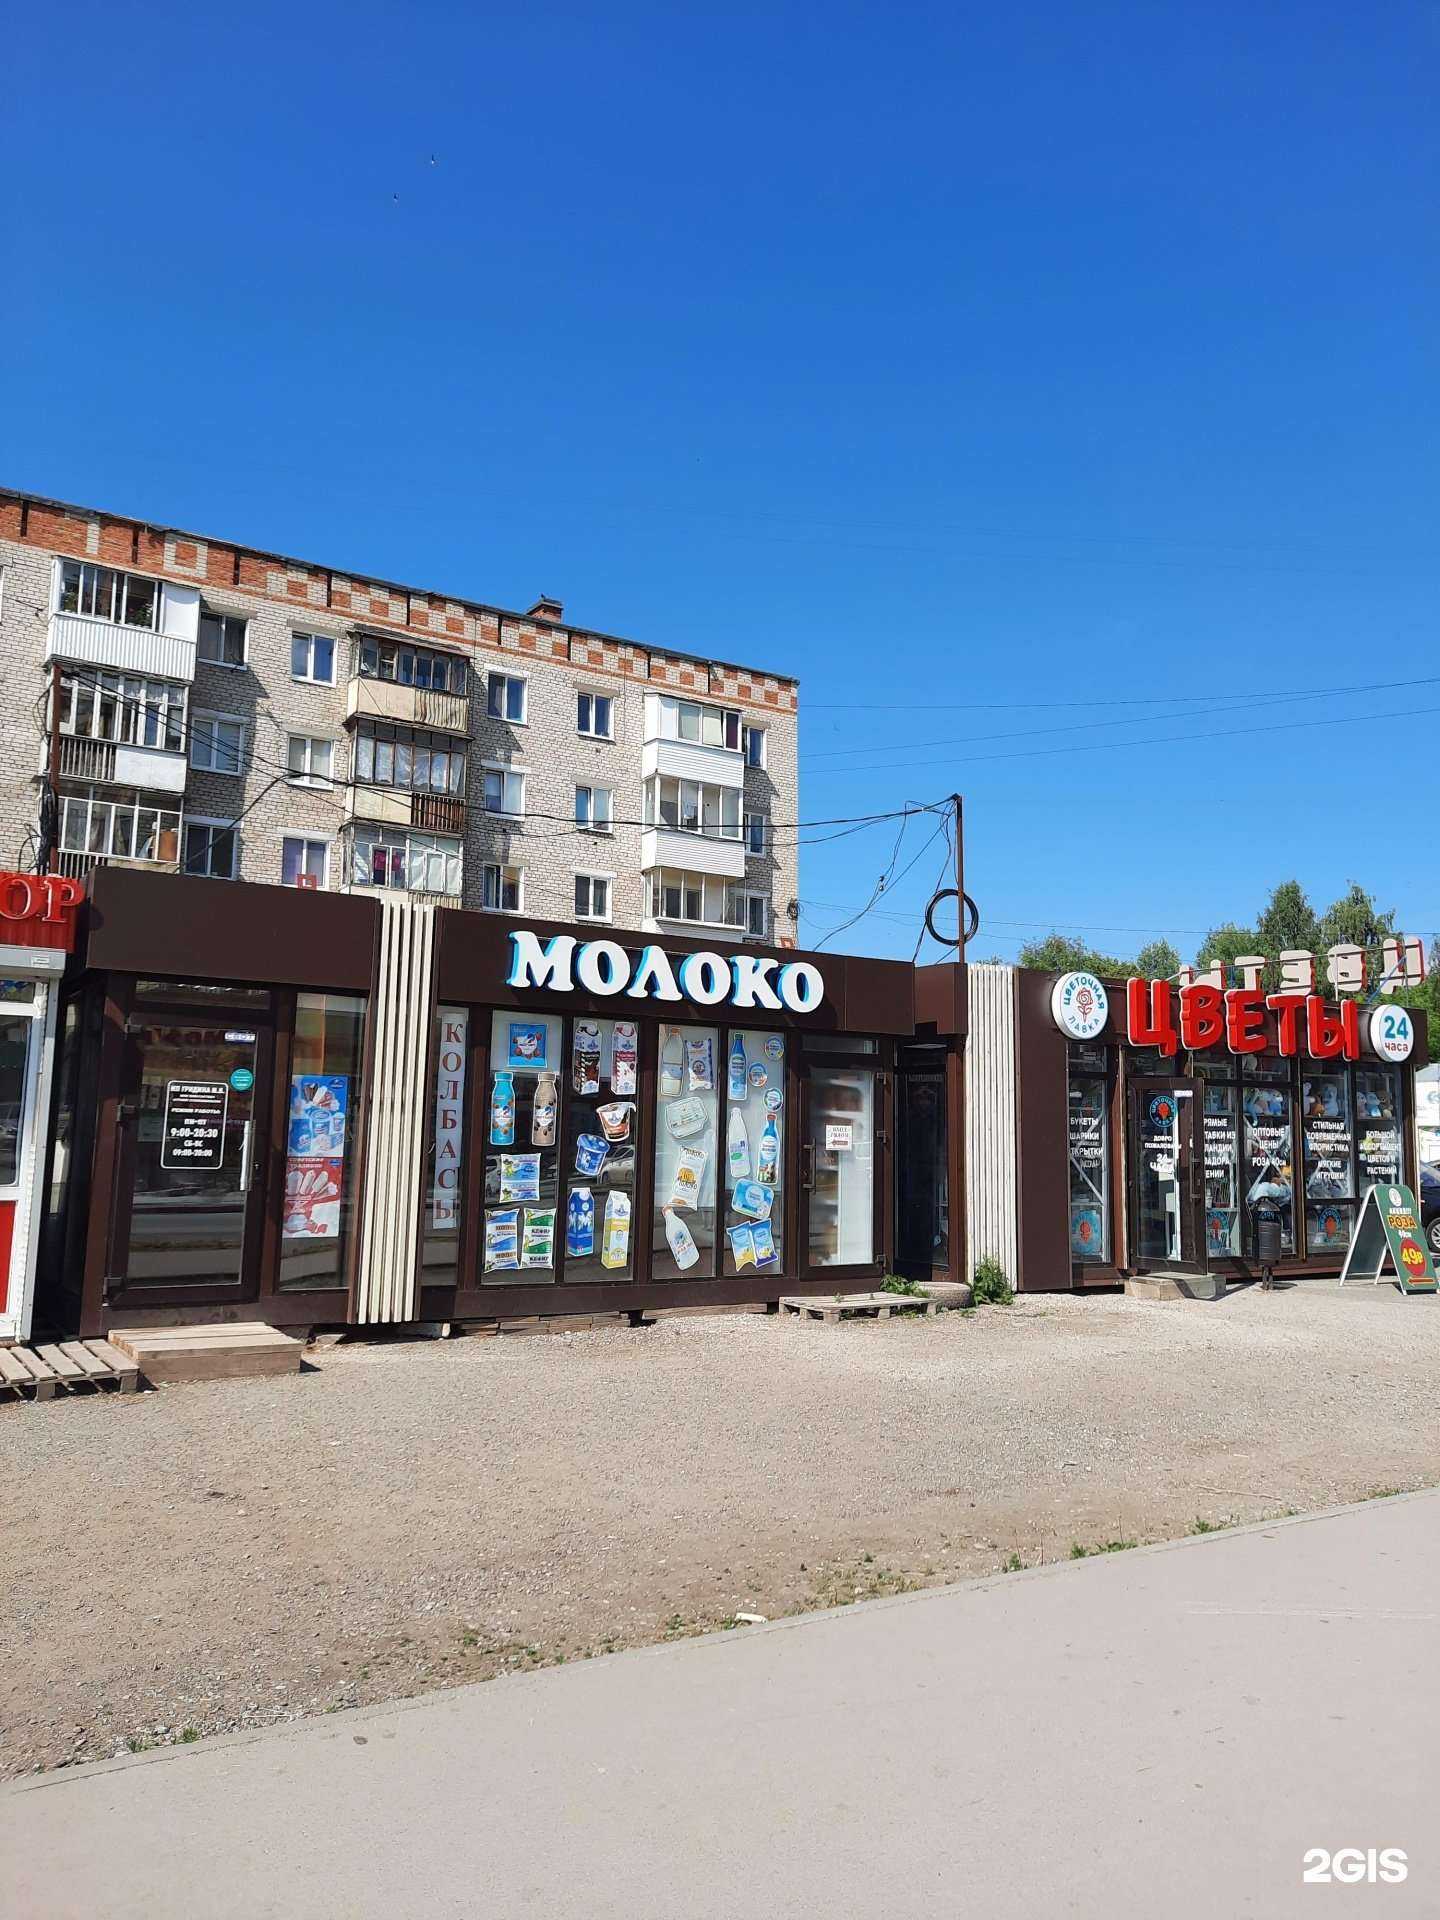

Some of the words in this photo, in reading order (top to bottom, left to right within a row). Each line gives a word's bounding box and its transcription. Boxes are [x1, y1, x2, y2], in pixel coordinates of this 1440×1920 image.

[506, 930, 825, 1014] МОЛОКО
[1064, 976, 1105, 1009] ЦВЕТОЧНАЯ
[1068, 1015, 1100, 1033] ЛАВКА
[1127, 977, 1360, 1062] ЦВЕТЫ
[1384, 1015, 1409, 1039] 24
[1384, 1042, 1409, 1052] часа
[434, 1023, 464, 1220] КОЛБАСЫ
[1070, 1117, 1098, 1126] БУКЕТЫ
[1203, 1118, 1228, 1127] РЯМЫЕ
[1312, 1121, 1345, 1131] СТИЛЬНАЯ
[170, 1127, 218, 1138] 9:00-20:30
[1069, 1132, 1099, 1140] ШАРИКИ
[1204, 1131, 1225, 1140] ТАВКИ
[1252, 1127, 1285, 1137] ОПТОВЫЕ
[1306, 1131, 1352, 1141] СОВРЕМЕННАЯ
[1204, 1143, 1234, 1152] ЛАНДИИ,
[1259, 1140, 1279, 1149] ЦЕНЫ
[1308, 1142, 1350, 1152] ФЛОРИСТИКА
[1070, 1147, 1103, 1156] ТКРЫТКИ
[1252, 1157, 1270, 1167] РОЗА
[1317, 1160, 1342, 1168] МЯГКИЕ
[1205, 1169, 1225, 1178] ЕНИИ
[1316, 1171, 1345, 1180] ИГРУШКИ
[1387, 1215, 1416, 1229] РОЗА
